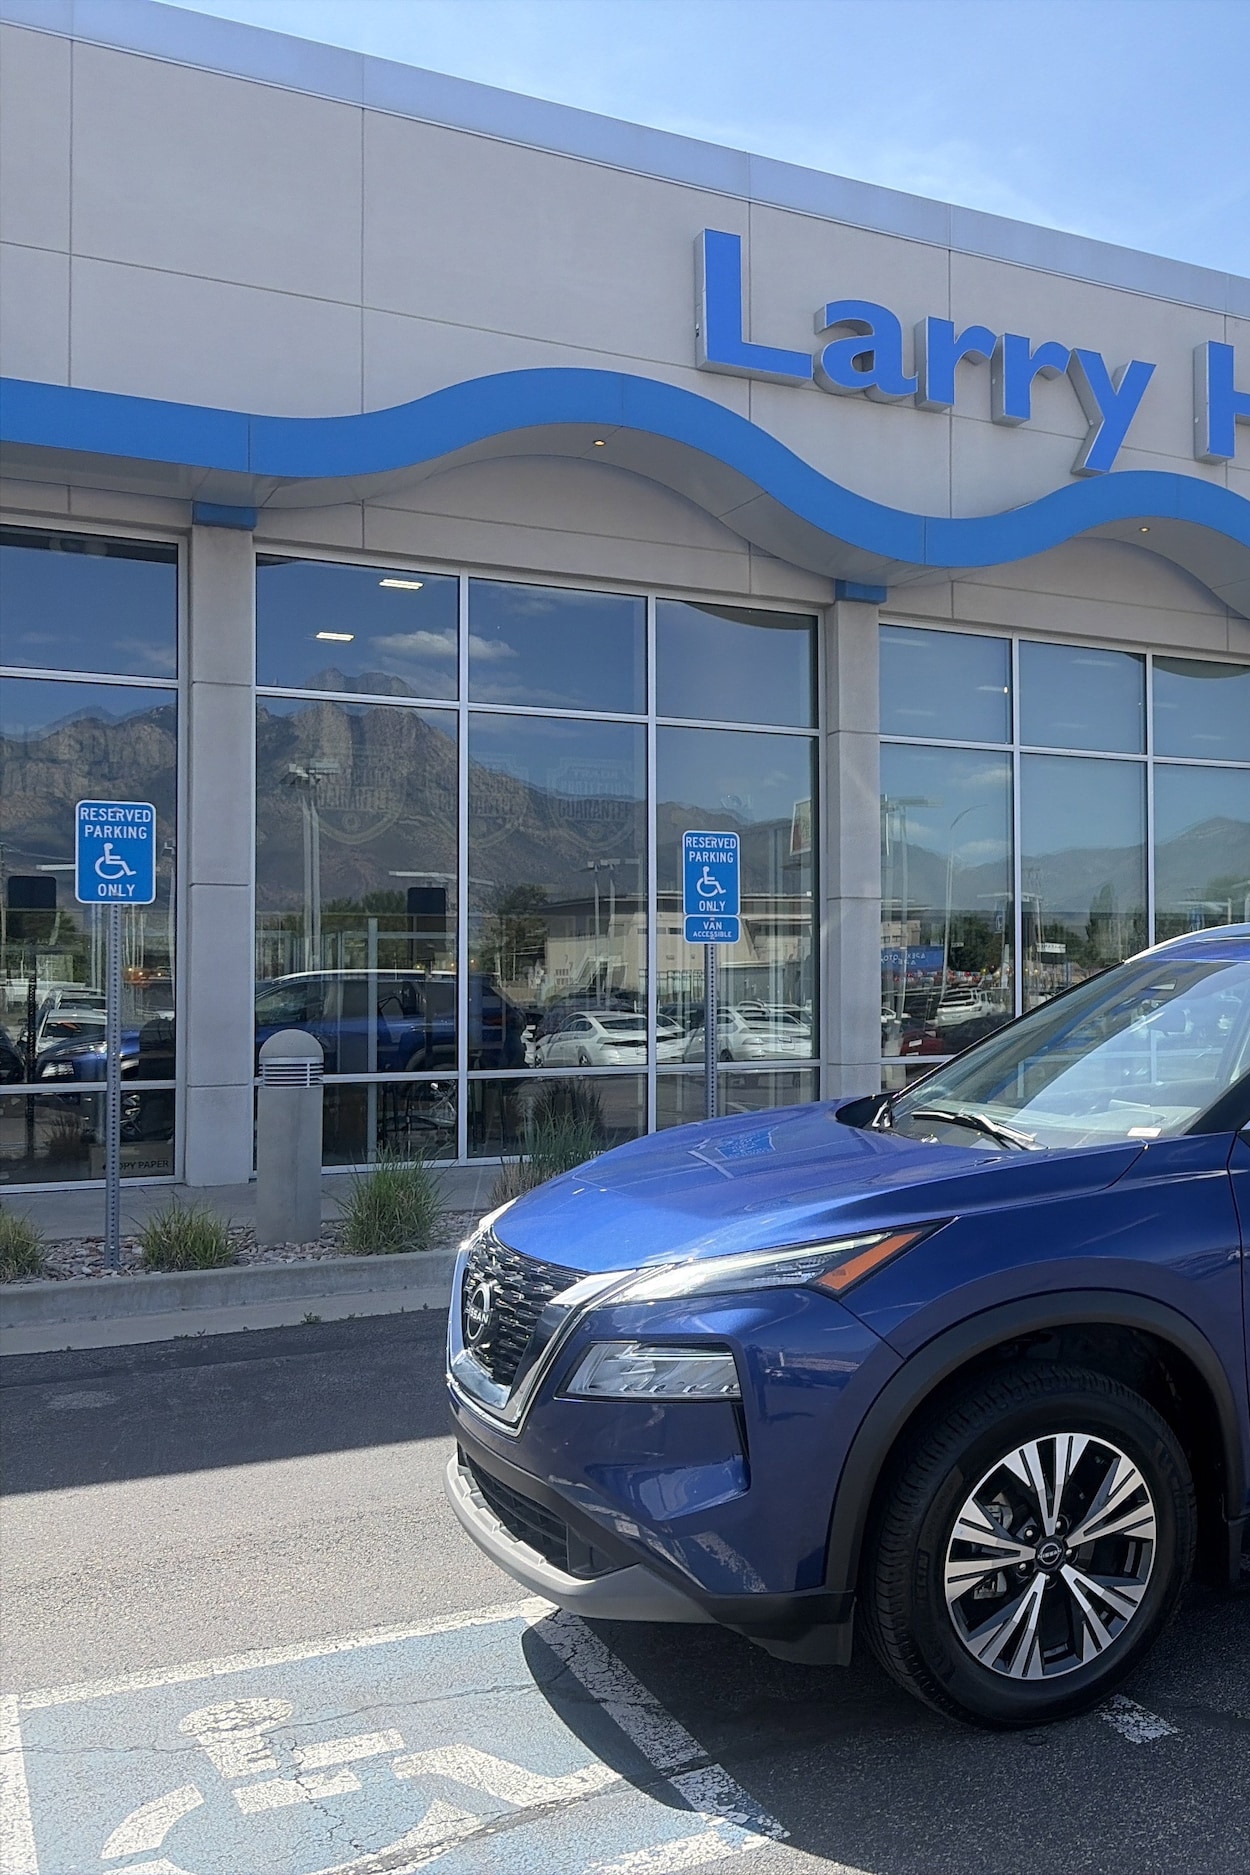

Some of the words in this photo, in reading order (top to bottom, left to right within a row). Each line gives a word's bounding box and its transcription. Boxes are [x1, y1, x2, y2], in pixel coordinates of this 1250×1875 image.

[695, 228, 1156, 477] Larry
[80, 807, 152, 822] RESERVED
[84, 825, 147, 839] PARKING
[685, 836, 736, 849] RESERVED
[689, 851, 734, 863] PARKING
[97, 883, 136, 897] ONLY
[699, 900, 726, 912] ONLY
[703, 921, 722, 930] VAN
[138, 1159, 169, 1169] PAPER
